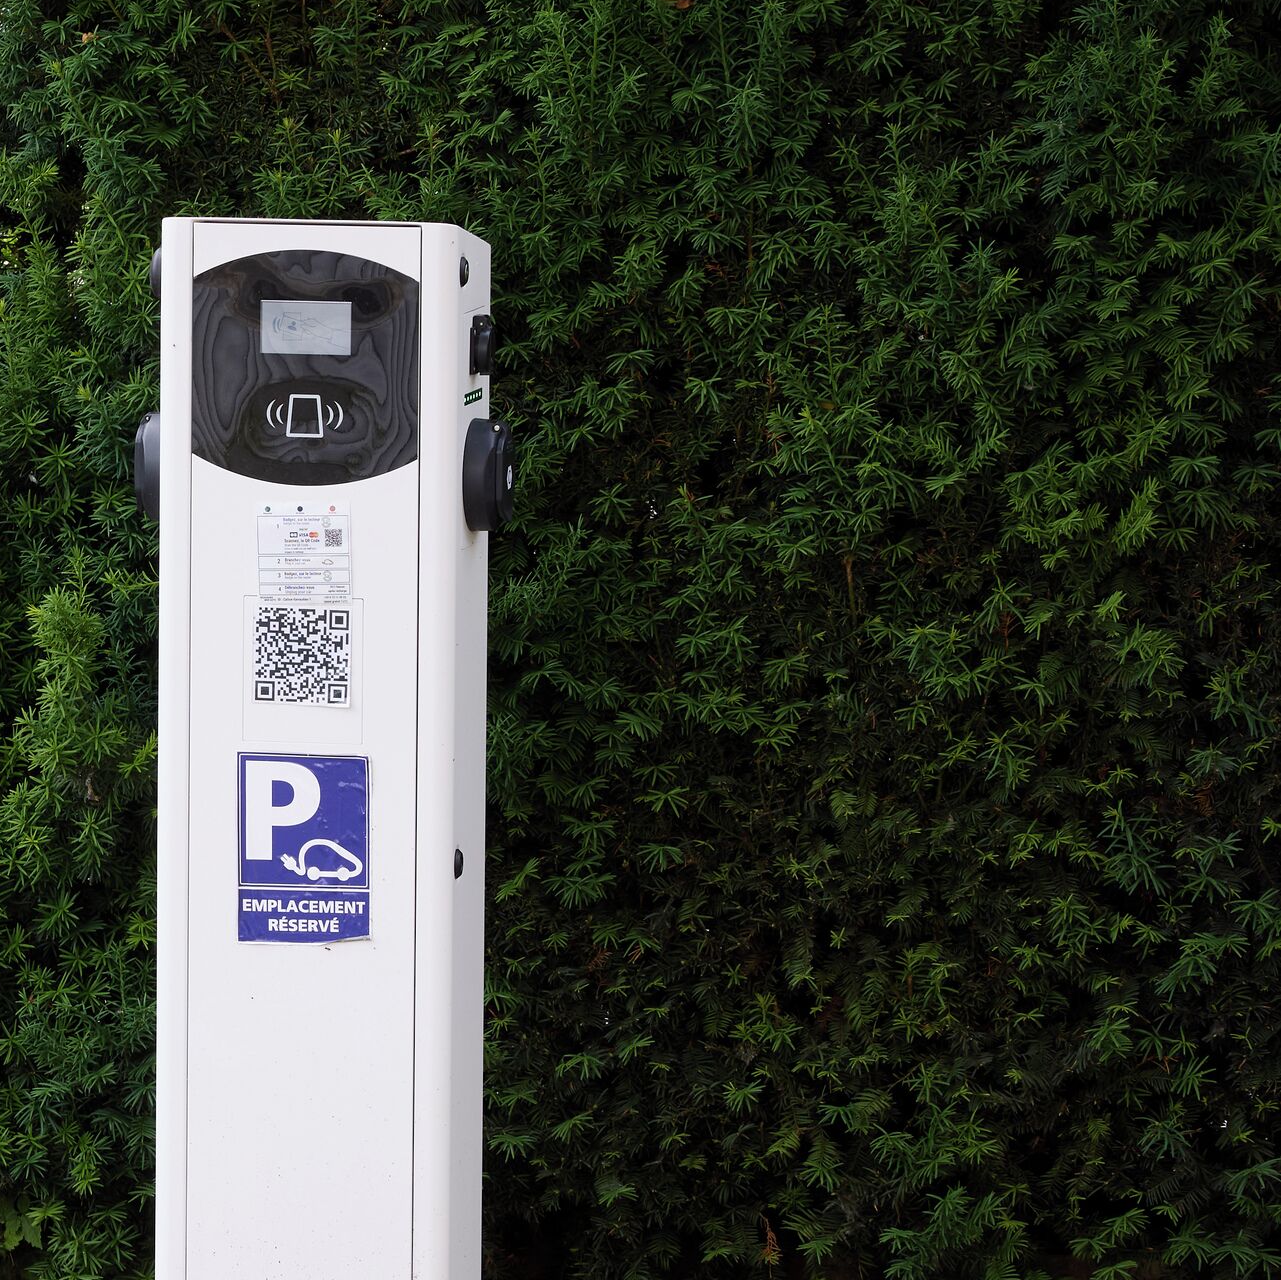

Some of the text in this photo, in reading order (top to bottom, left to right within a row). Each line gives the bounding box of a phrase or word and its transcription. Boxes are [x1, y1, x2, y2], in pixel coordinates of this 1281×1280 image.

[246, 760, 320, 860] P
[242, 899, 365, 915] EMPLACEMENT
[268, 917, 340, 933] RÉSERVÉ
